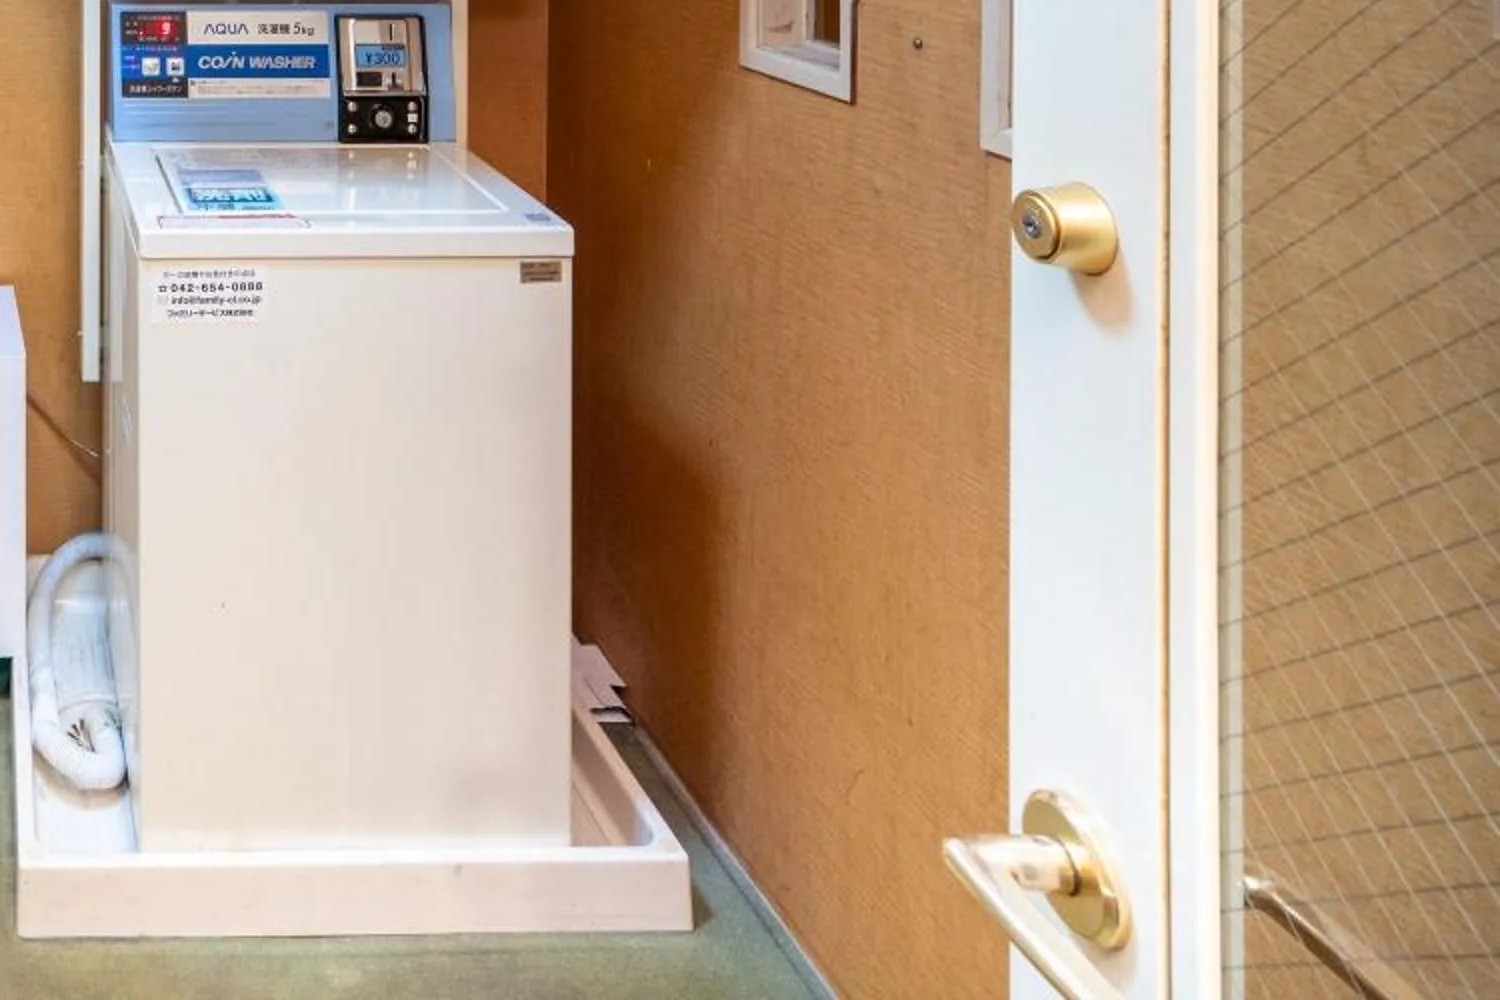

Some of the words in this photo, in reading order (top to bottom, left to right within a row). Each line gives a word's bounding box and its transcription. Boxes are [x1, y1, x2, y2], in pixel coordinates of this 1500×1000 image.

[203, 23, 249, 35] AQUA
[257, 23, 290, 35] 洗濯機
[293, 21, 315, 36] 5kg
[249, 55, 317, 69] WASHER
[365, 51, 400, 65] ¥300
